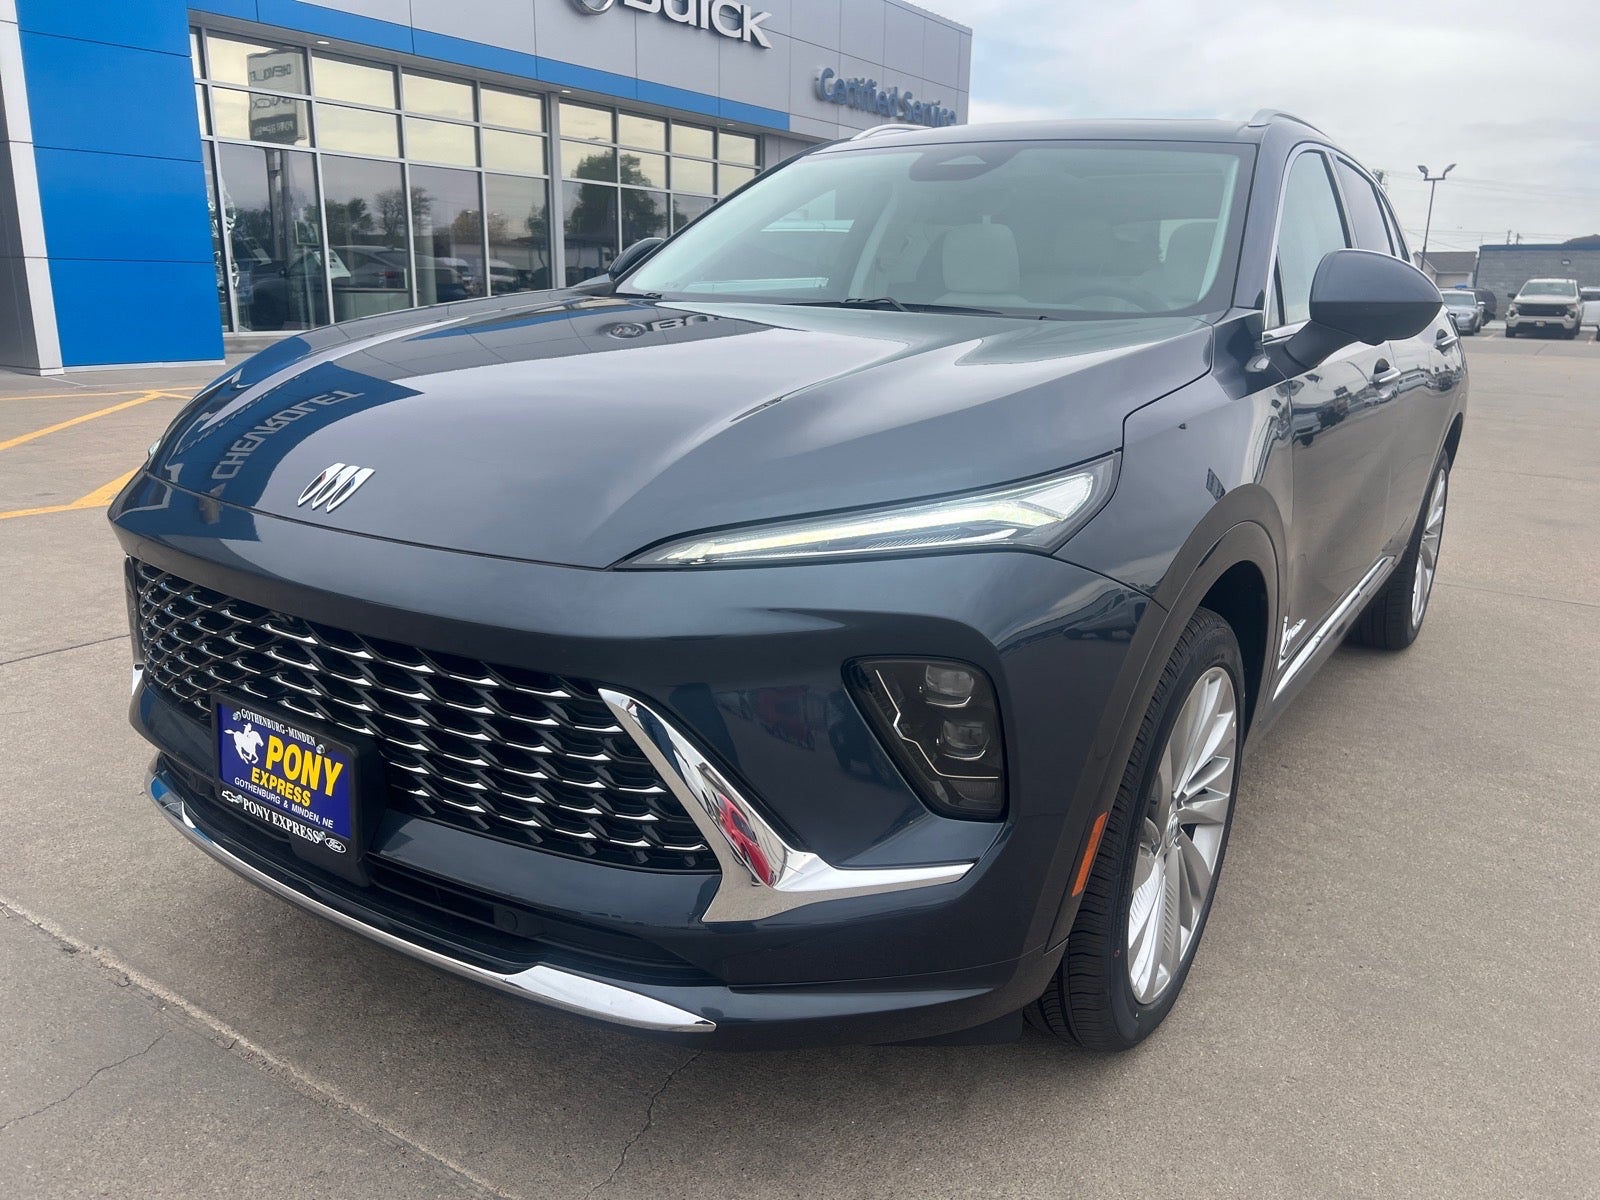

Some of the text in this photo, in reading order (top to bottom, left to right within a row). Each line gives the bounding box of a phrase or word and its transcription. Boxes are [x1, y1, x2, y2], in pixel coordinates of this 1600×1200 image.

[818, 67, 957, 128] Certified Service
[241, 708, 317, 746] GOTHENBURG-MINDEN
[251, 766, 312, 807] EXPRESS
[265, 734, 344, 797] PONY
[234, 777, 334, 829] GOTHENBURG & MINDEN, NE
[242, 797, 321, 845] PONY EXPRESS
